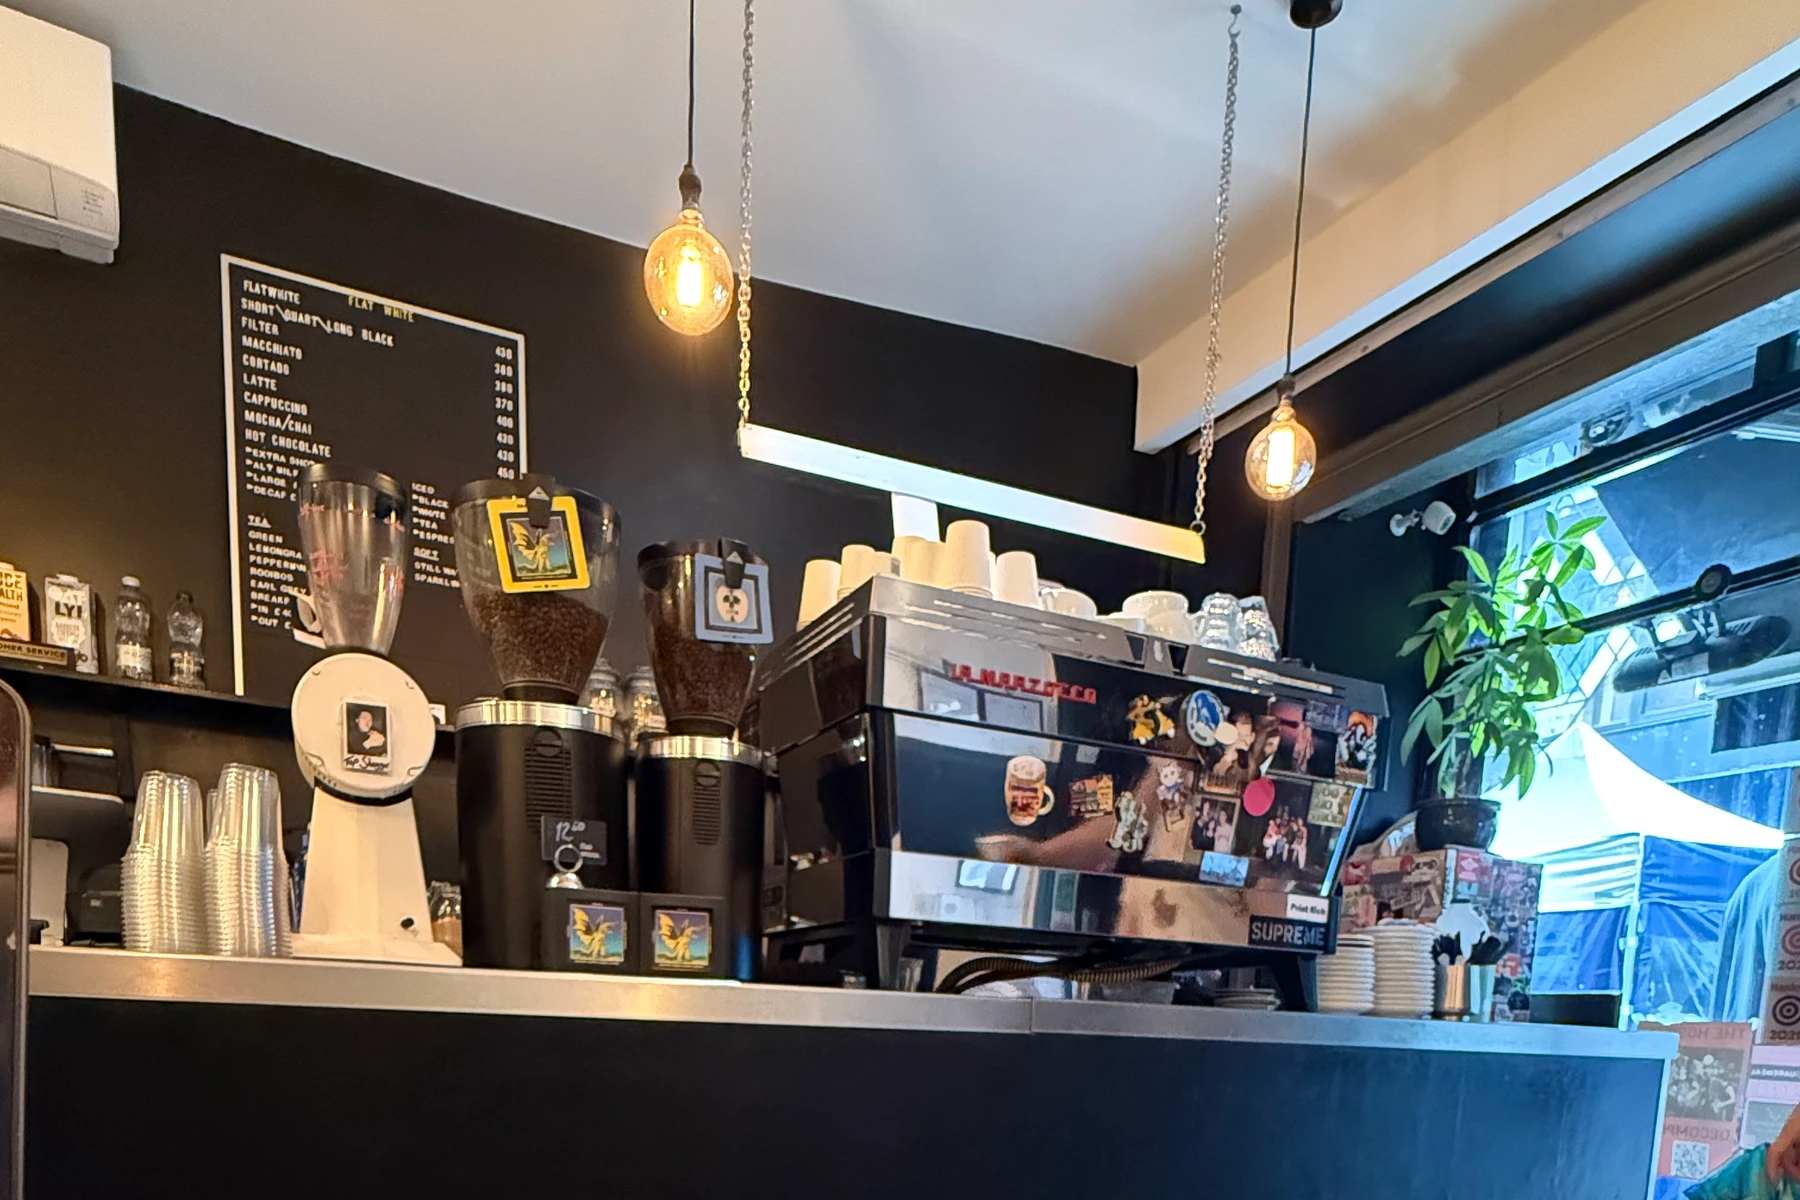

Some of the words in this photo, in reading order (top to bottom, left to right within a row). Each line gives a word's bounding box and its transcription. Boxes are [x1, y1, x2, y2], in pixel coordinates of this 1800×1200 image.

[348, 295, 374, 311] FLAT
[383, 305, 414, 323] WHITE
[241, 316, 279, 336] FILTER
[361, 328, 394, 347] BLACK
[242, 335, 302, 360] MACCHIATO
[242, 354, 290, 376] CORTADO
[243, 372, 277, 391] LATTE
[244, 391, 308, 416] CAPPUCCINO
[244, 410, 312, 435] MOCHA/CHAI
[245, 428, 266, 443] HOT
[271, 434, 331, 458] CHOCOLATE
[252, 449, 286, 463] EXTRA
[253, 461, 273, 472] ALT
[253, 473, 286, 488] LARGE
[253, 485, 286, 499] DECAF
[412, 483, 435, 495] ICED
[420, 496, 449, 509] BLACK
[248, 515, 269, 526] TEA
[420, 519, 438, 530] TEA
[248, 530, 284, 543] GREEN
[420, 530, 455, 545] ESPRES
[249, 542, 303, 560] LEMONGRA
[249, 554, 307, 572] PEPPERMIN
[414, 561, 441, 574] STILL
[250, 566, 294, 582] ROOIBOS
[250, 579, 277, 591] EARL
[250, 591, 290, 606] BREAKF
[257, 616, 279, 628] OUT
[26, 646, 66, 658] SERVICE
[1251, 922, 1326, 946] SUPREME
